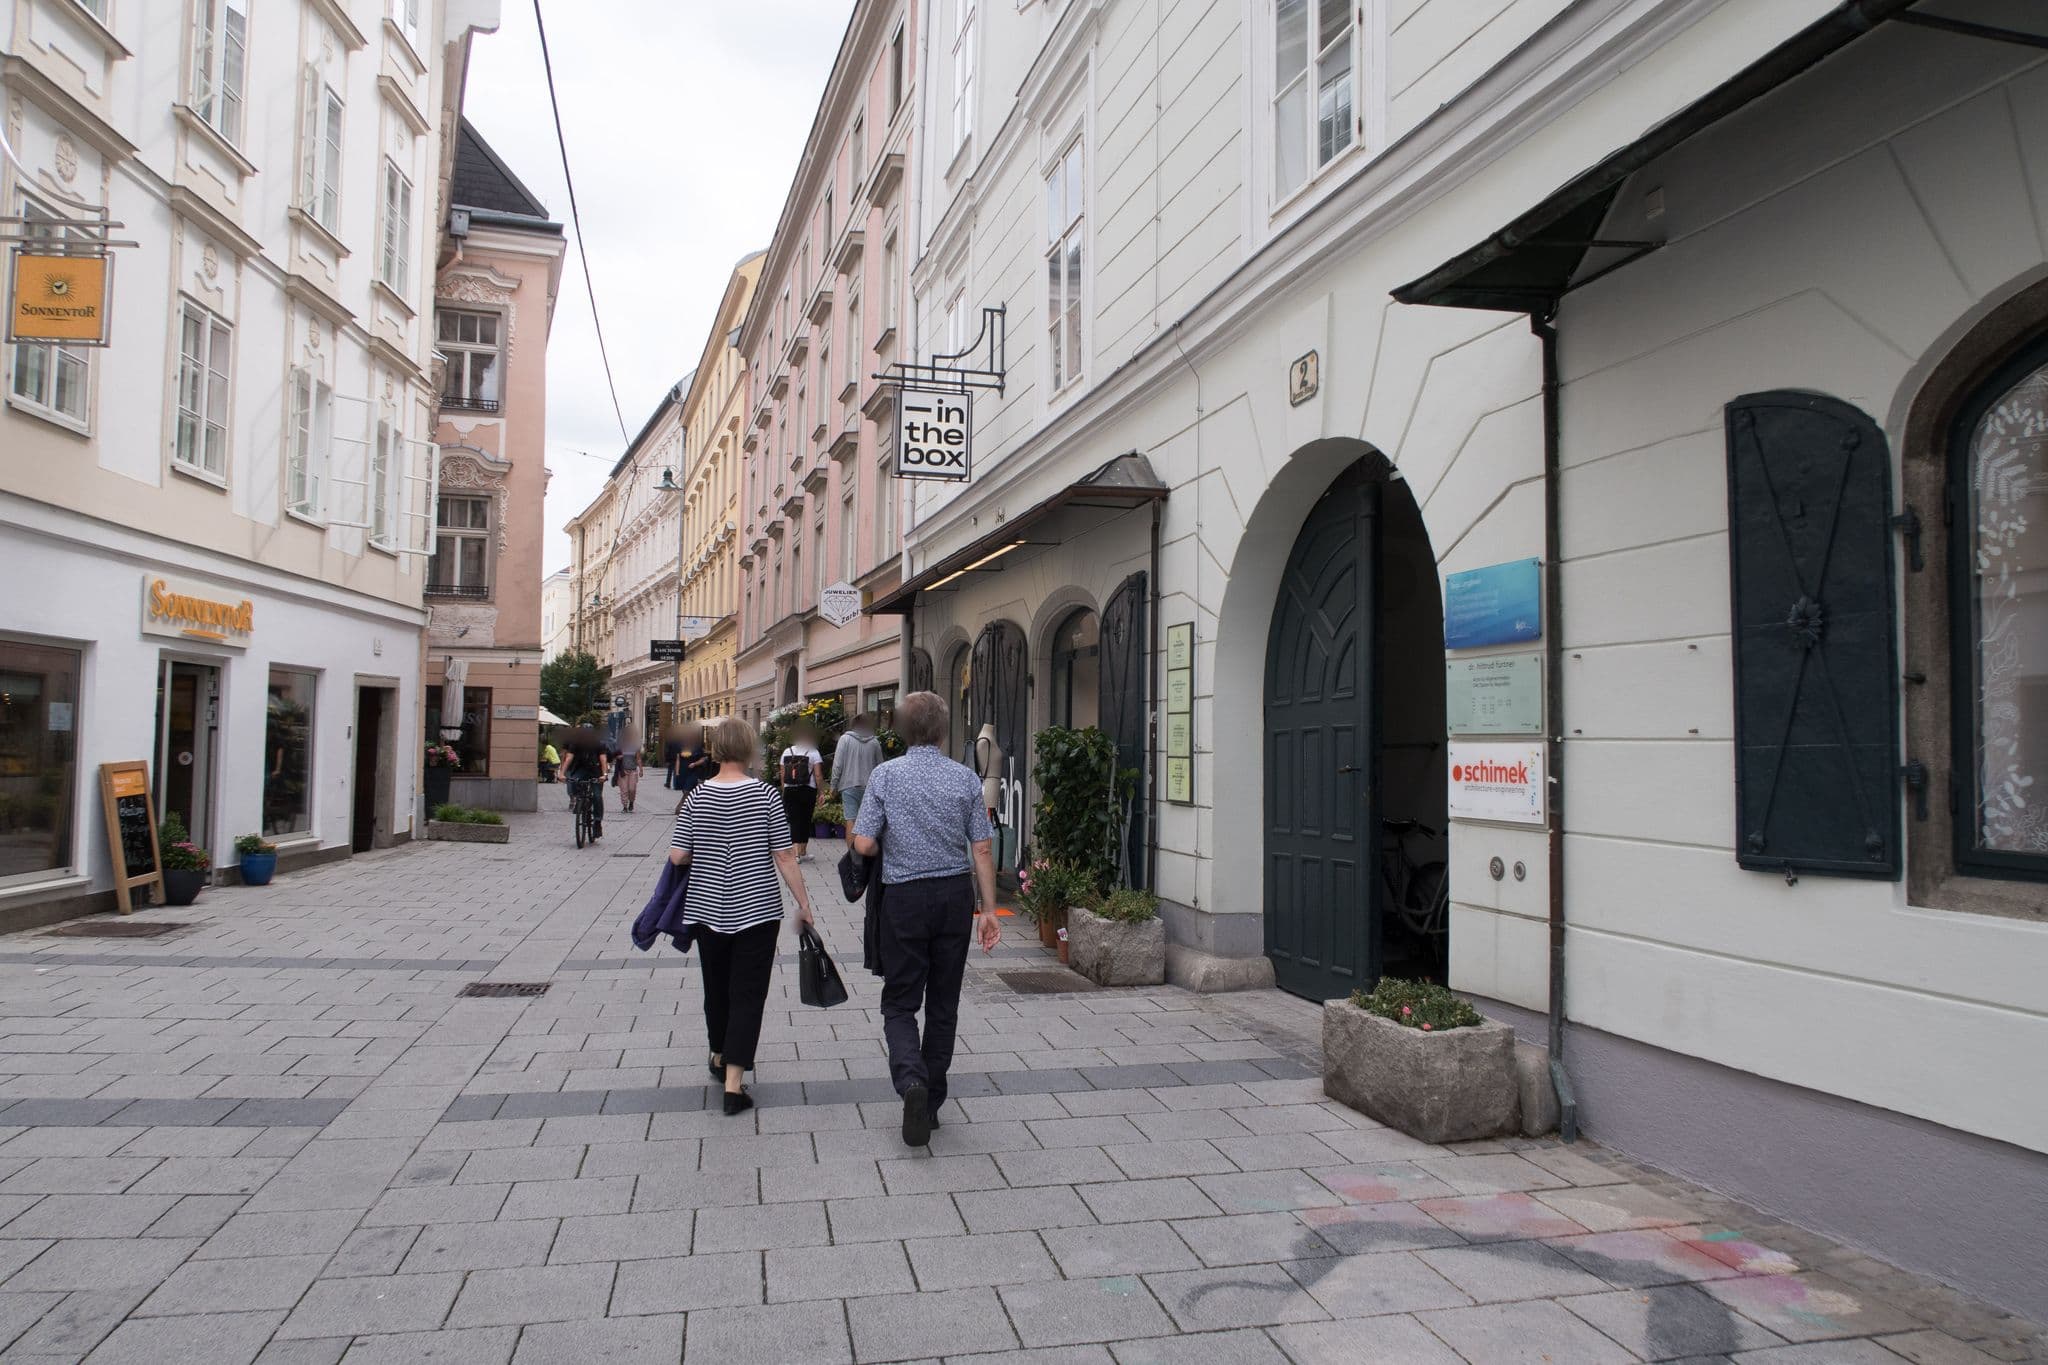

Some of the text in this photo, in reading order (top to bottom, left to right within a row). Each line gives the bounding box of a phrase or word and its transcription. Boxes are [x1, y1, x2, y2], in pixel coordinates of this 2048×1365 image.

[21, 303, 96, 318] SONNENTOR
[1299, 360, 1308, 390] 2
[904, 421, 965, 446] the
[903, 442, 965, 468] box
[1463, 759, 1529, 784] schimek
